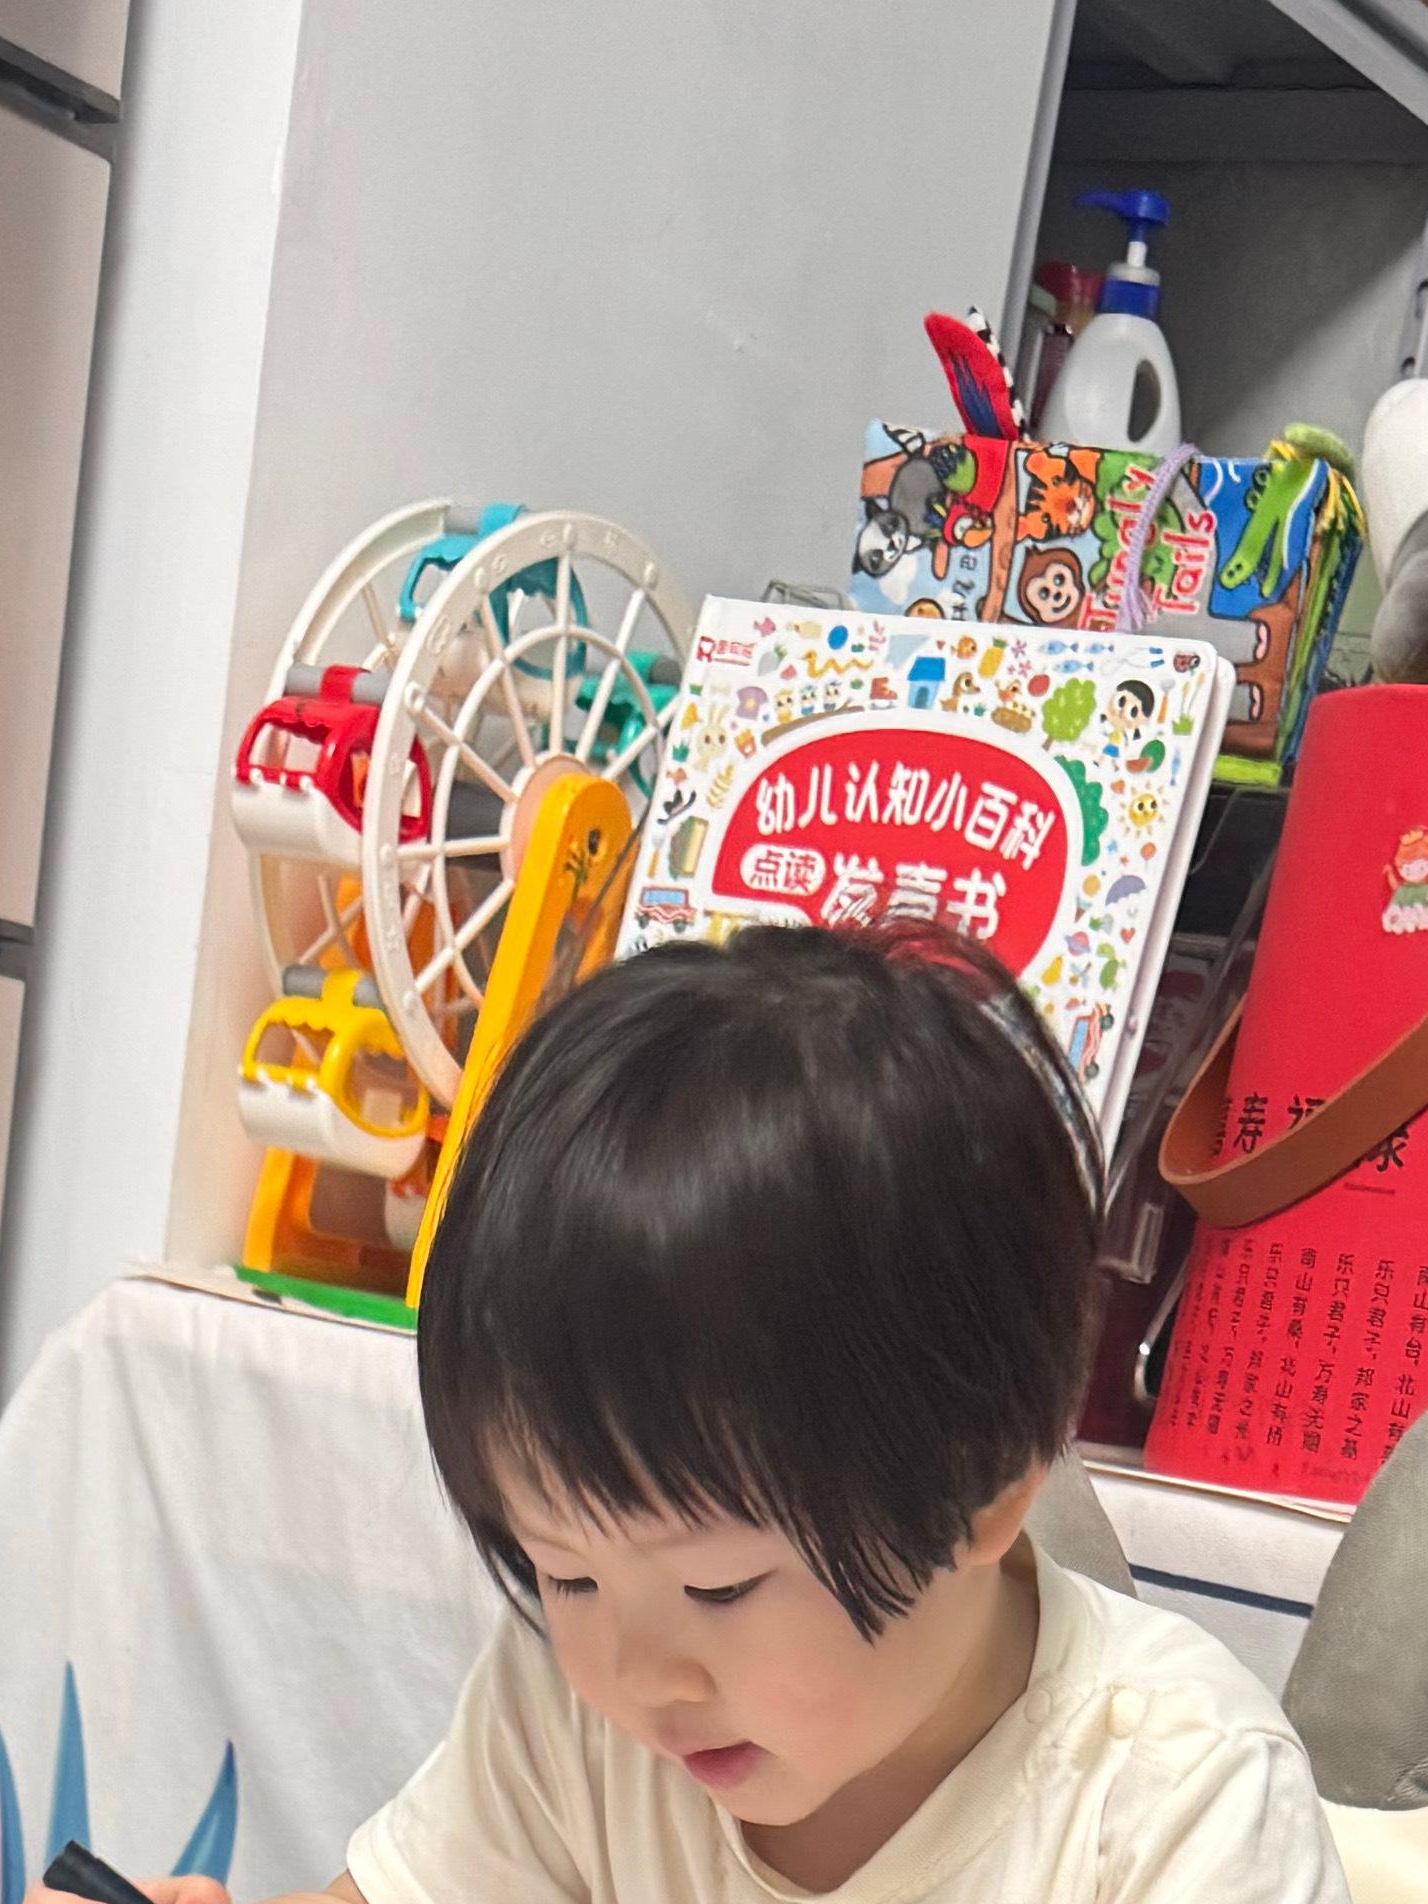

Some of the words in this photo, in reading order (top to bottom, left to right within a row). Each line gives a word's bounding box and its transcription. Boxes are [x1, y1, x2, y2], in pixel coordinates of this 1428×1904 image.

[1149, 510, 1217, 623] Tails
[755, 759, 1058, 869] 幼儿认知小百科
[747, 850, 822, 896] 点读
[822, 850, 1007, 942] 发声书
